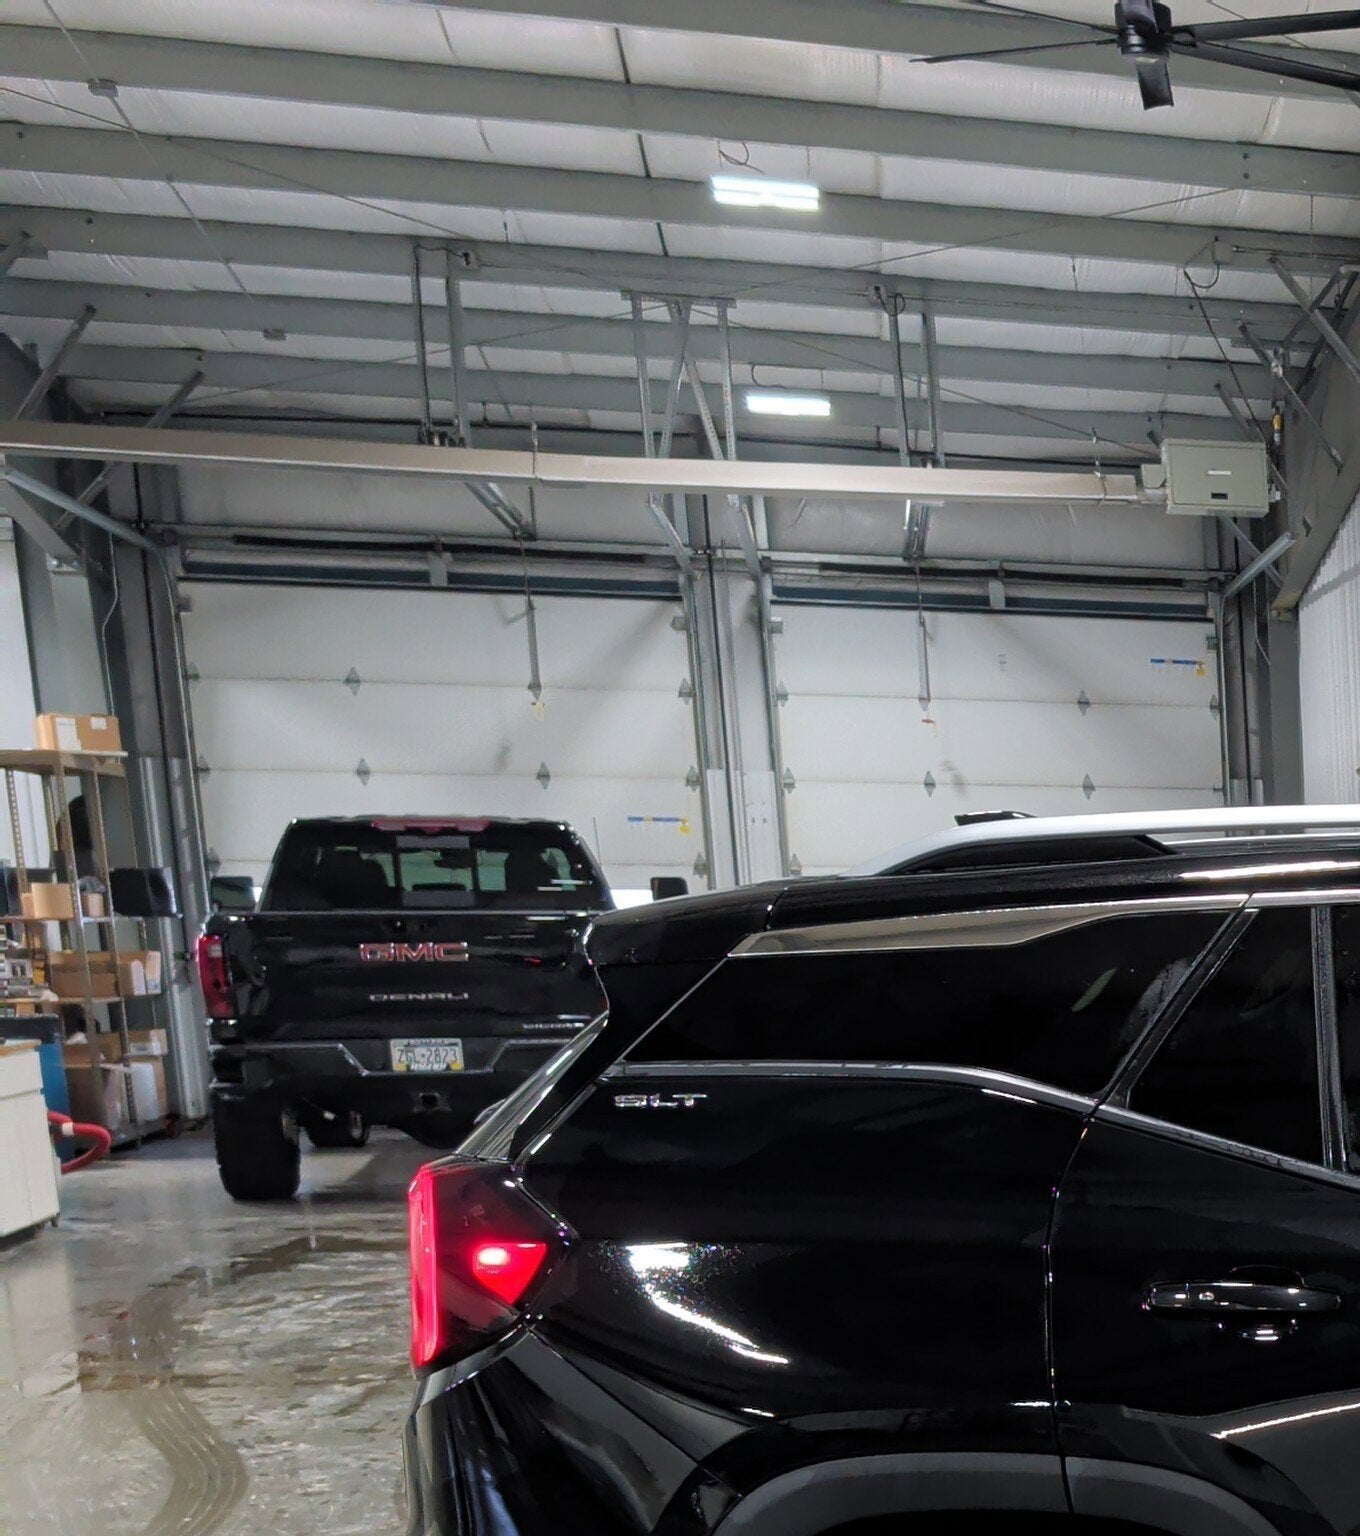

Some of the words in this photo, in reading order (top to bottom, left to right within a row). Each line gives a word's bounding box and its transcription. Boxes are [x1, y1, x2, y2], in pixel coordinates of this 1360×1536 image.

[359, 942, 469, 961] GMC
[369, 993, 469, 1001] DENALI
[614, 1093, 707, 1107] SLT
